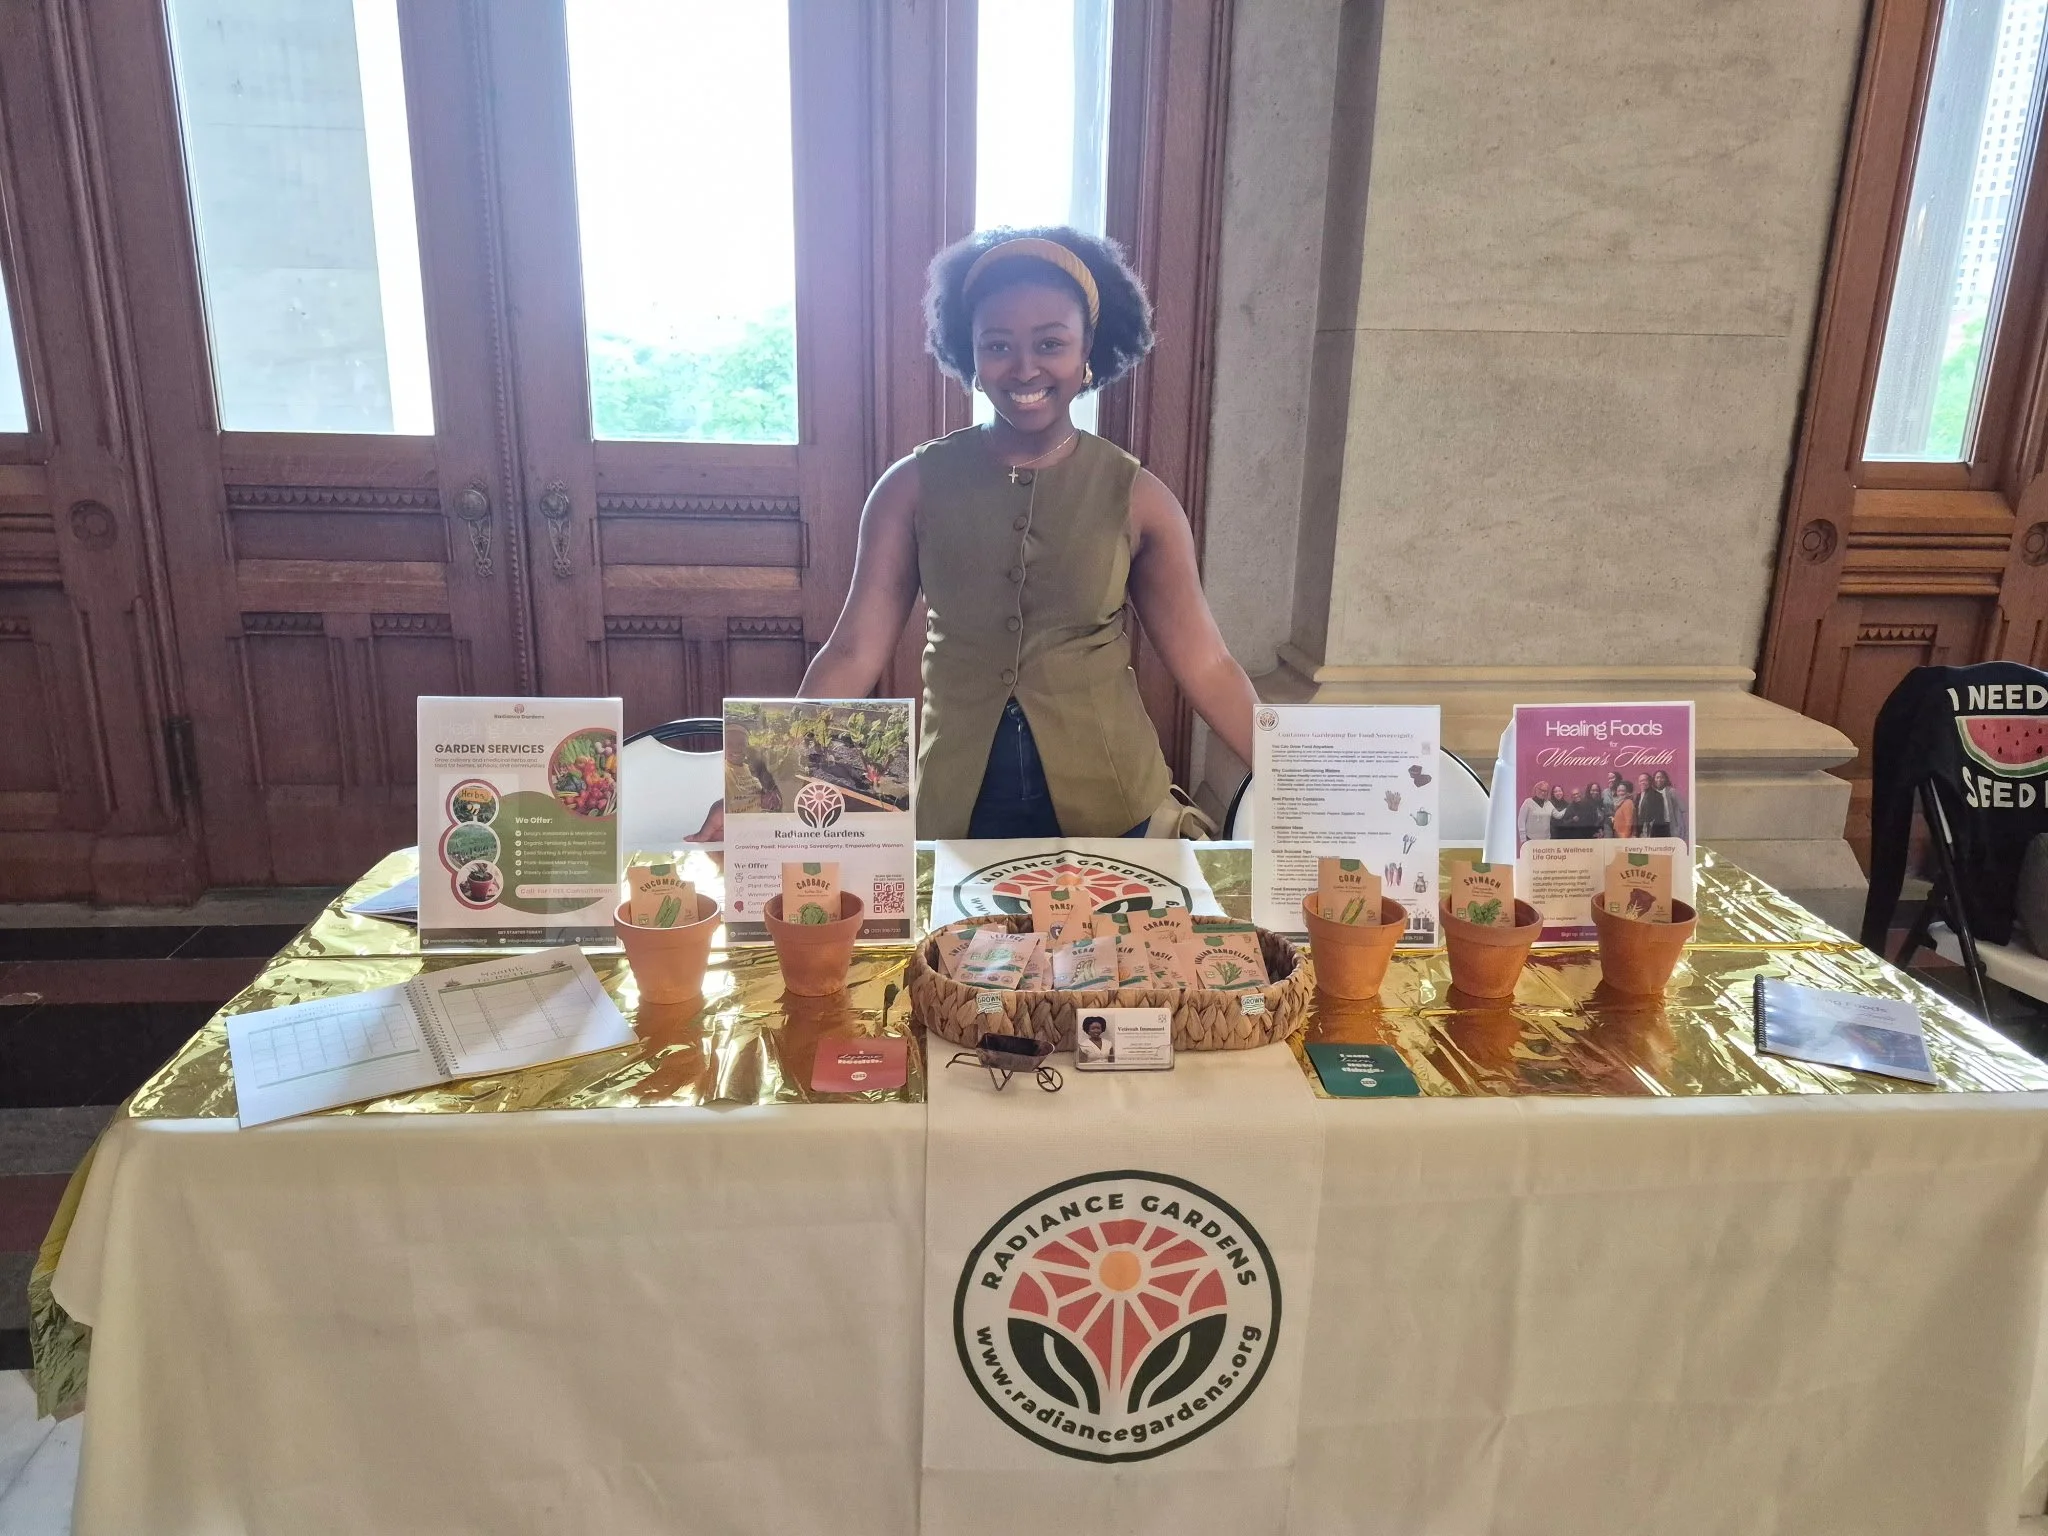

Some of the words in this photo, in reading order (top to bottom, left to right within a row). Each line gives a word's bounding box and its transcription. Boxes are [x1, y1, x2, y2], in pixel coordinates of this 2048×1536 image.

[1946, 687, 1960, 712] I
[1968, 685, 2048, 710] NEED
[1546, 720, 1608, 740] Healing
[1610, 720, 1663, 736] Foods
[435, 744, 485, 754] GARDEN
[488, 744, 545, 754] SERVICES
[1536, 745, 1611, 768] Women's
[1613, 745, 1678, 768] Health
[1962, 766, 2037, 809] SEED
[774, 830, 821, 838] Radiance
[823, 830, 865, 838] Gardens
[1077, 857, 1168, 885] GARDENS
[1620, 869, 1658, 882] LETTUCE
[639, 878, 687, 893] CUCUMBER
[796, 878, 831, 890] CABBAGE
[1338, 874, 1361, 885] CORN
[1463, 876, 1502, 888] SPINACH
[1143, 920, 1181, 931] CARAWAY
[1212, 949, 1255, 963] DANDELION
[981, 1194, 1124, 1290] RADIANCE
[1141, 1195, 1257, 1287] GARDENS
[976, 1325, 1262, 1443] www.radiancegardens.org
